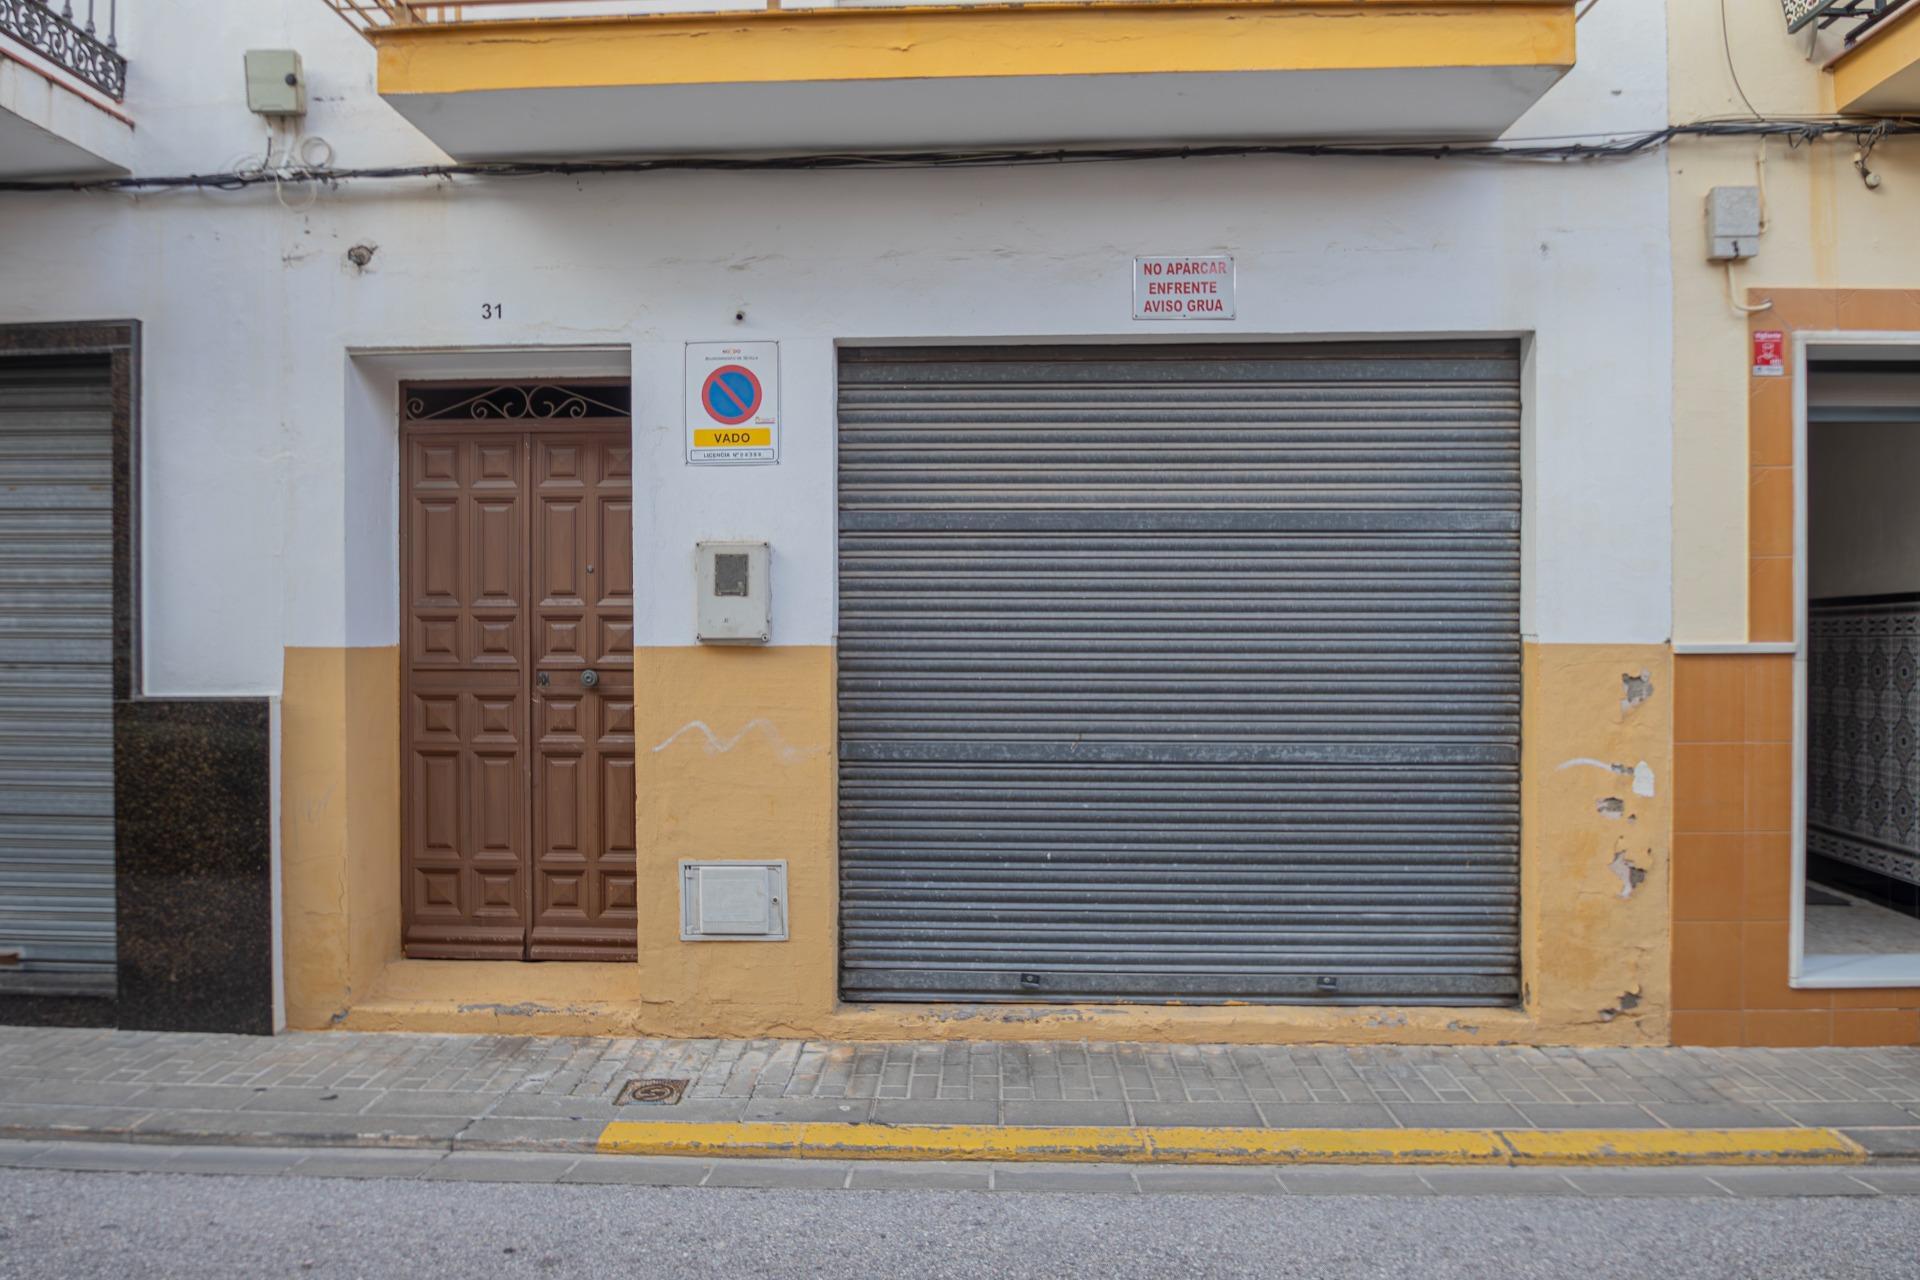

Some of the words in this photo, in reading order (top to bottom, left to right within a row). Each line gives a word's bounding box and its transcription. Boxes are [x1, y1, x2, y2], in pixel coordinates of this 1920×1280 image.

[1144, 263, 1162, 275] NO
[1166, 262, 1227, 275] APARCAR
[1149, 282, 1217, 295] ENFRENTE
[482, 303, 502, 320] 31
[1144, 300, 1183, 312] AVISO
[1187, 299, 1223, 312] GRUA
[714, 432, 750, 443] VADO
